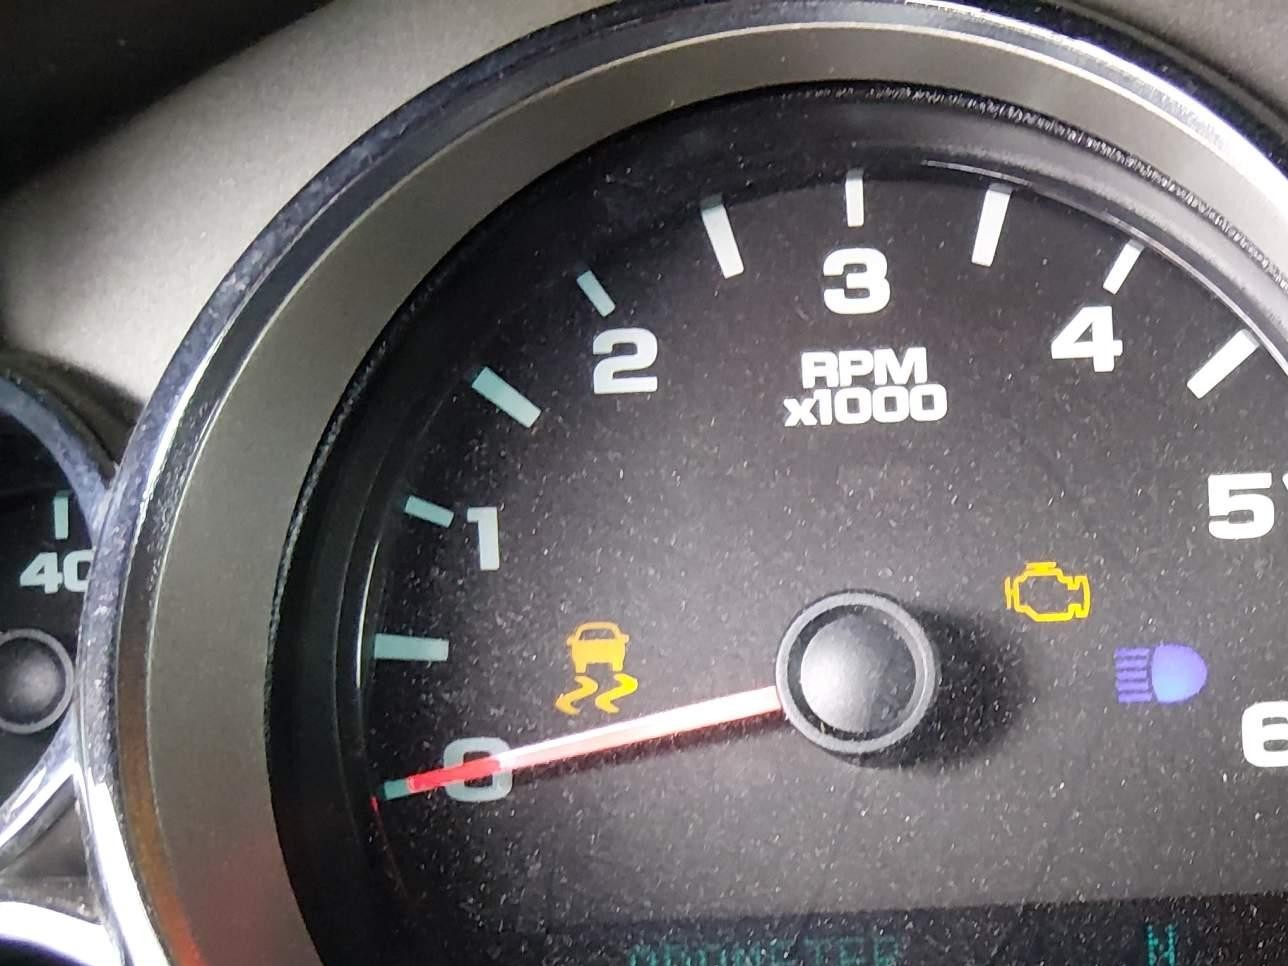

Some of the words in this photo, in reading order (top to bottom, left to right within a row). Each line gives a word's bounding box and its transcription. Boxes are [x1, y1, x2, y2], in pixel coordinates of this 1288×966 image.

[823, 248, 890, 314] 3
[593, 328, 658, 393] 2
[801, 347, 927, 387] RPM
[1051, 306, 1122, 371] 4
[784, 383, 947, 427] x1000
[1208, 472, 1275, 539] 5
[468, 507, 500, 570] 1
[443, 737, 512, 802] 0
